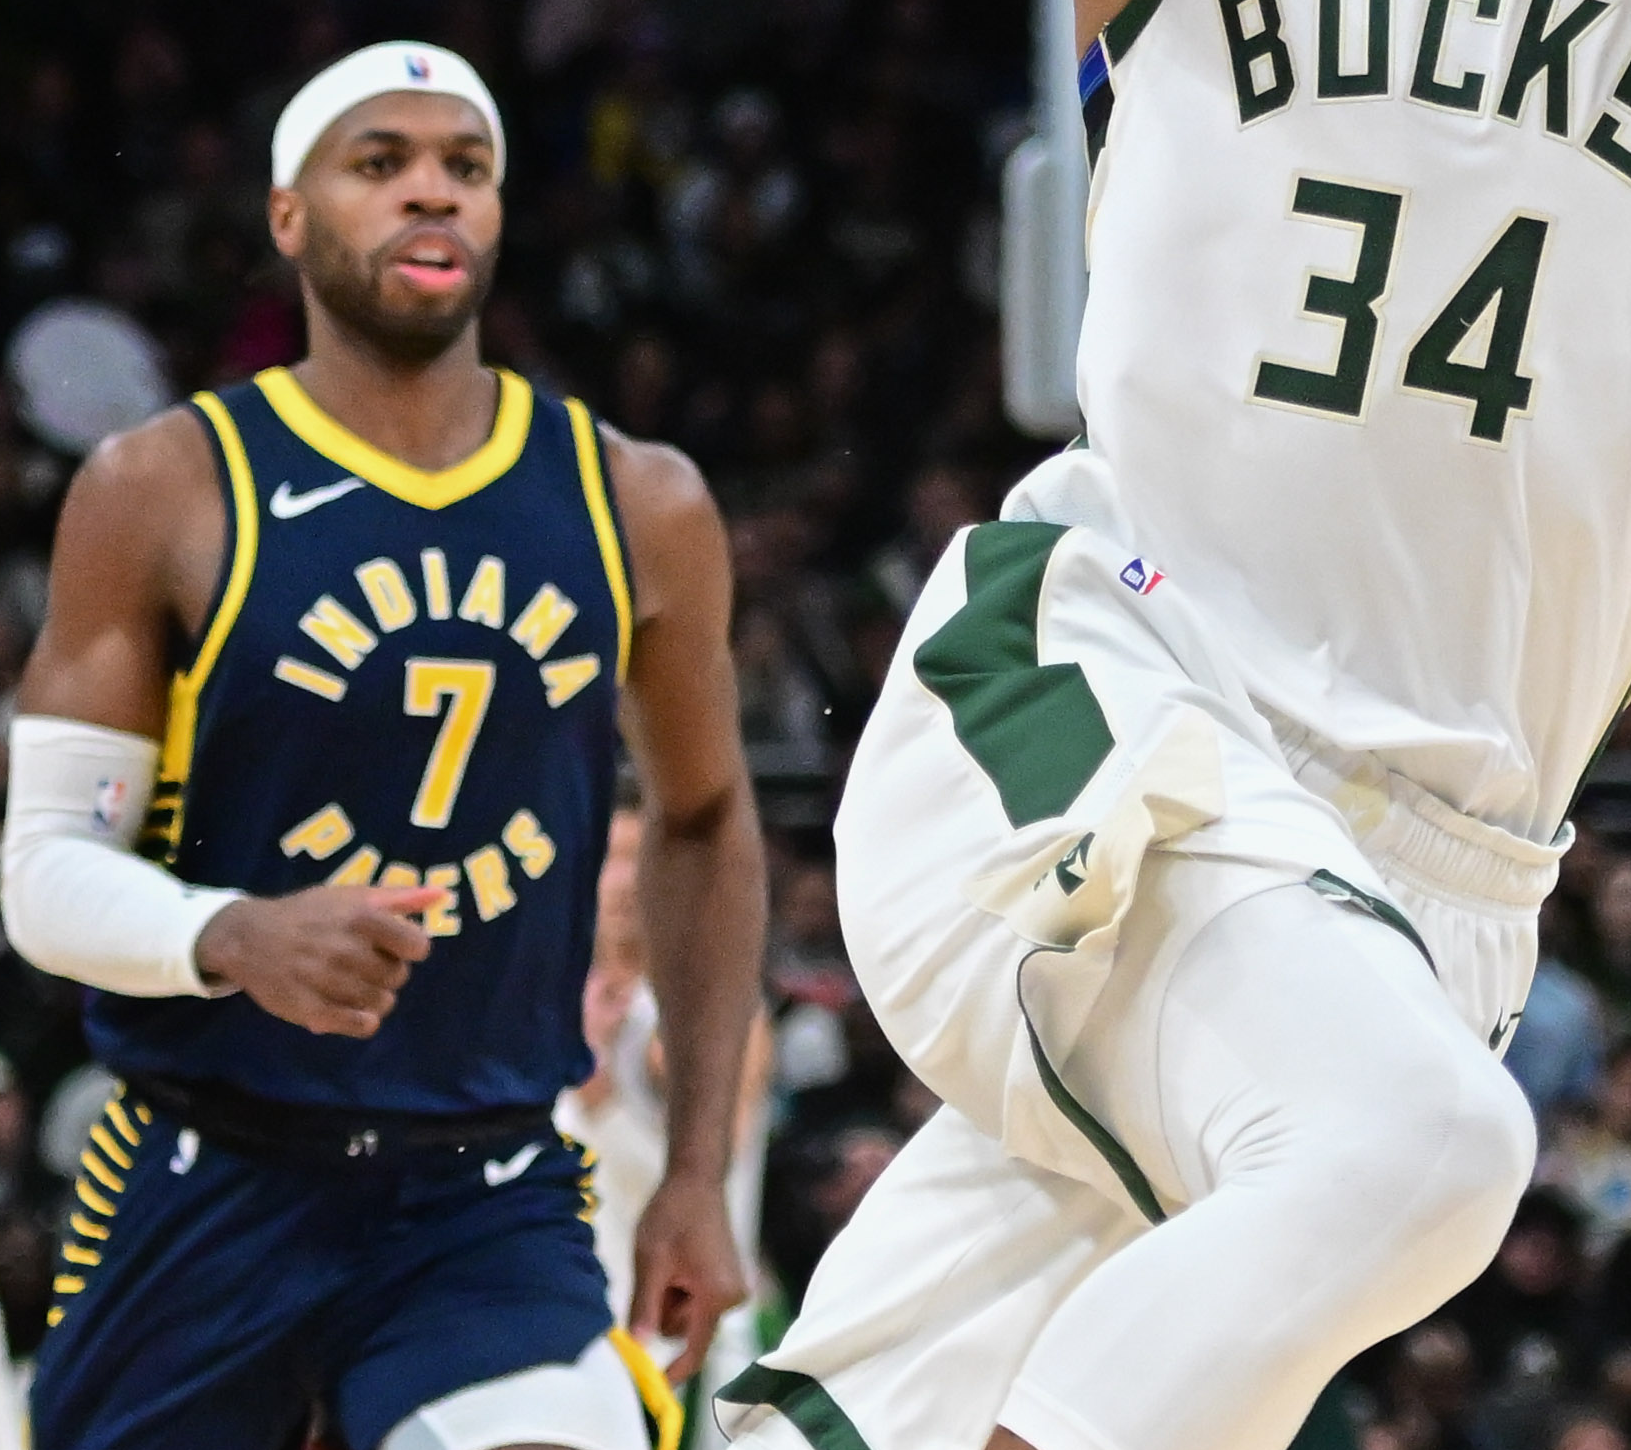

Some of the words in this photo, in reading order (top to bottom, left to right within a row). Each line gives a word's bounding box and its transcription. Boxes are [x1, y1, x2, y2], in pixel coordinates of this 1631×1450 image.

[1247, 174, 1557, 450] 34
[274, 548, 601, 709] INDIANA
[403, 657, 496, 829] 7
